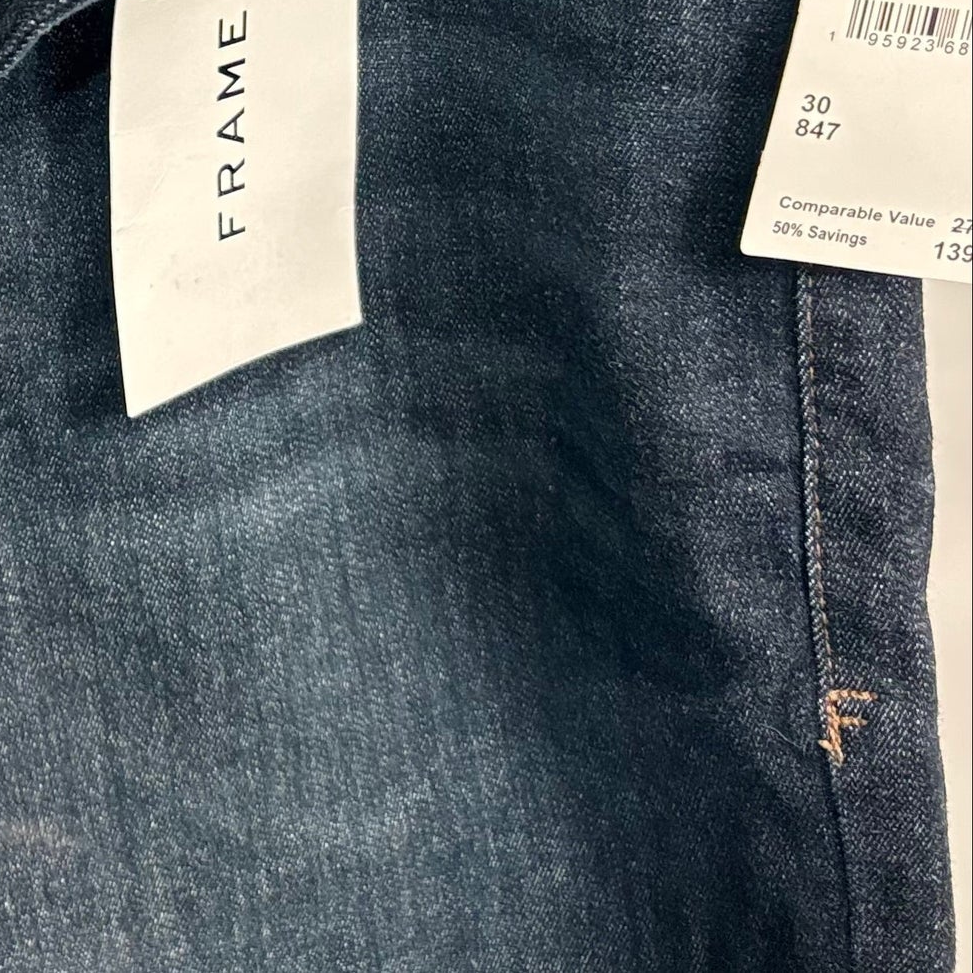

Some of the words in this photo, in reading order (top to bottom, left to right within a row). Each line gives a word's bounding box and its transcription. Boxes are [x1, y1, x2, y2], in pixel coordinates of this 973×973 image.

[829, 31, 835, 42] 1
[868, 32, 935, 53] 95923
[801, 94, 831, 114] 30
[217, 9, 248, 242] FRAME
[795, 118, 841, 140] 847
[779, 195, 883, 222] Comparable
[889, 210, 936, 228] Value
[772, 220, 803, 238] 50%
[807, 226, 868, 248] Savings
[818, 689, 878, 766] F
